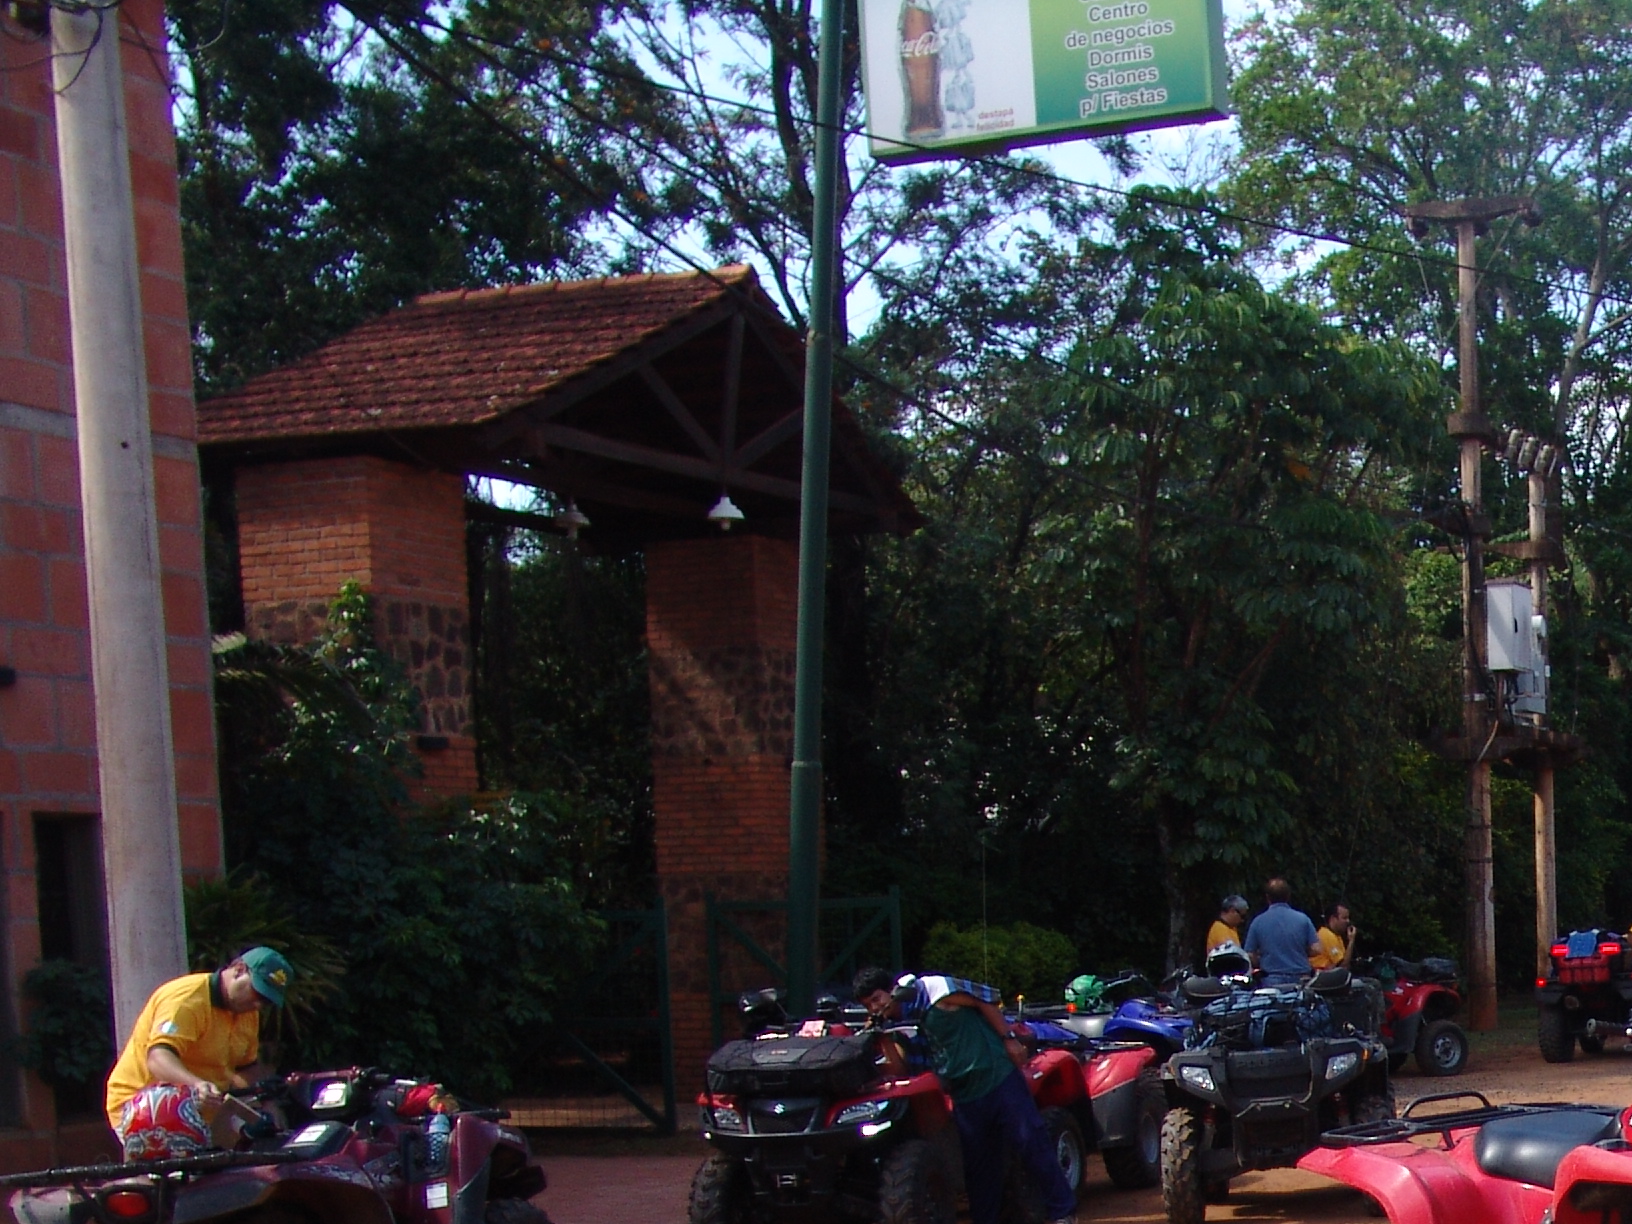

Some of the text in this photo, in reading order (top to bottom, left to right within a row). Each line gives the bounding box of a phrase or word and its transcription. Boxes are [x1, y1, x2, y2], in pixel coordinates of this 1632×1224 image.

[1088, 2, 1149, 22] Centro
[1066, 20, 1173, 48] de negocios
[1089, 45, 1152, 66] Dormis
[1087, 68, 1157, 89] Salones
[1081, 89, 1166, 116] p/ Fiestas
